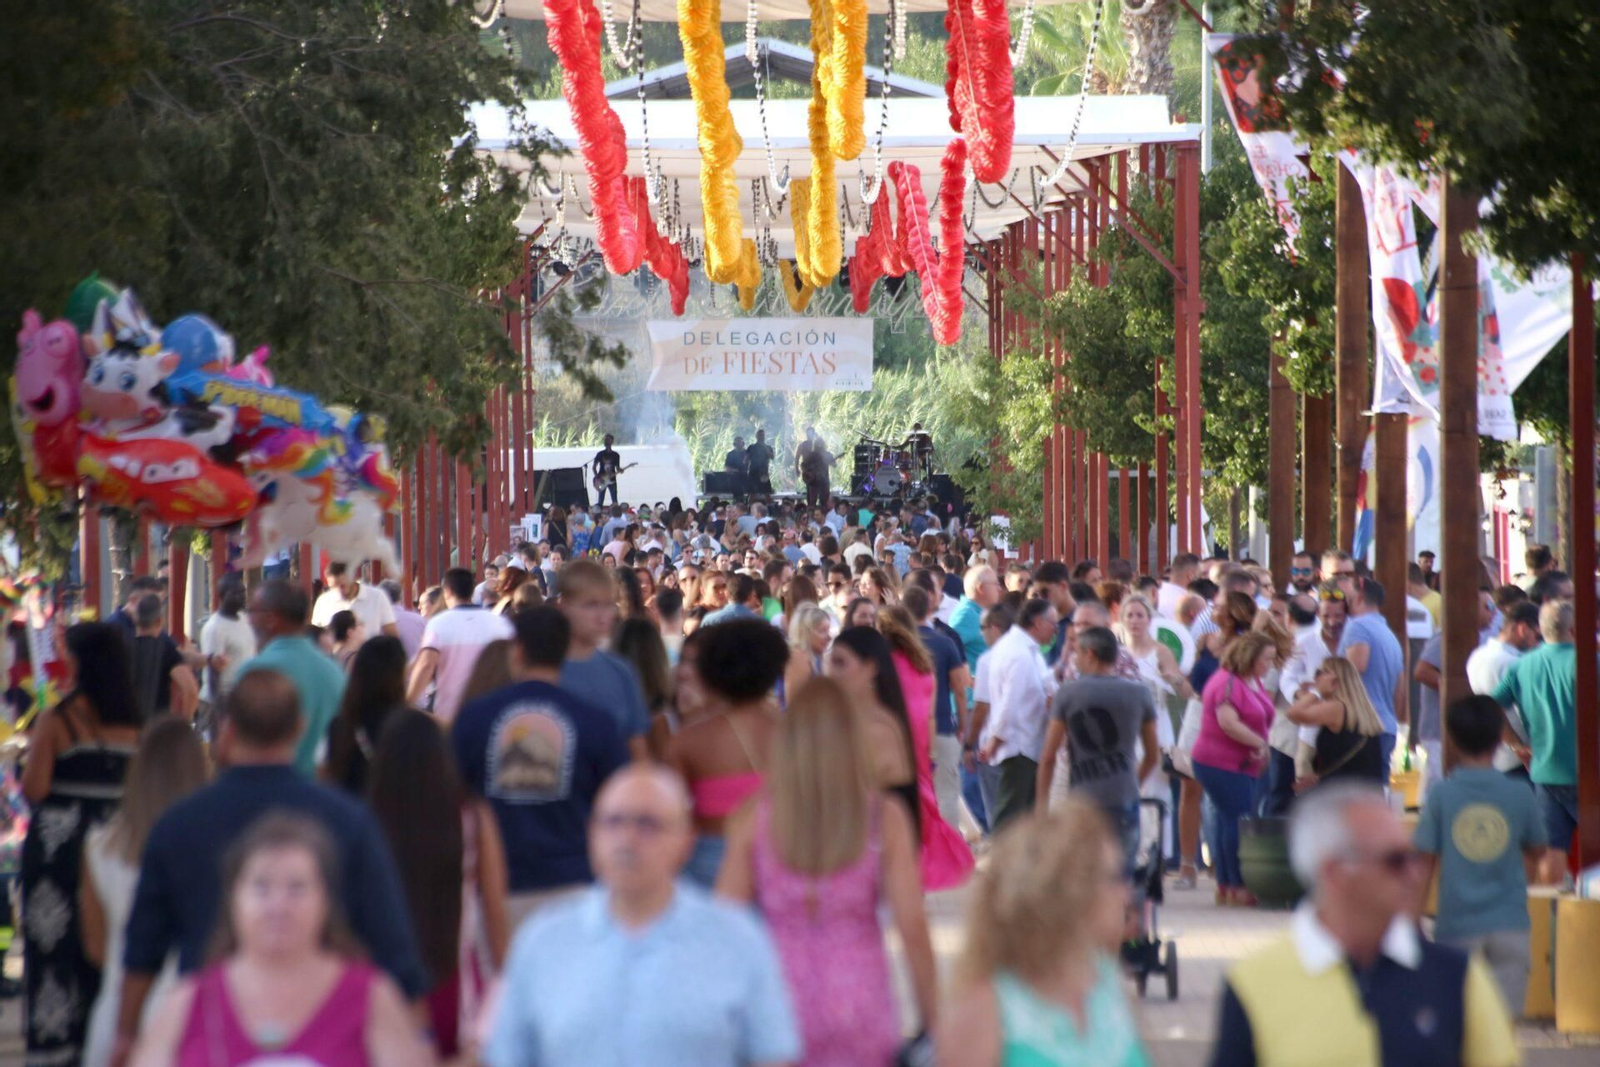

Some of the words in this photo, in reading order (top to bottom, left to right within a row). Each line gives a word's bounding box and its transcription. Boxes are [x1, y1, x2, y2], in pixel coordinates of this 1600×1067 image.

[683, 329, 836, 346] DELEGACIÓN
[684, 357, 712, 374] DE
[722, 351, 837, 374] FIESTAS
